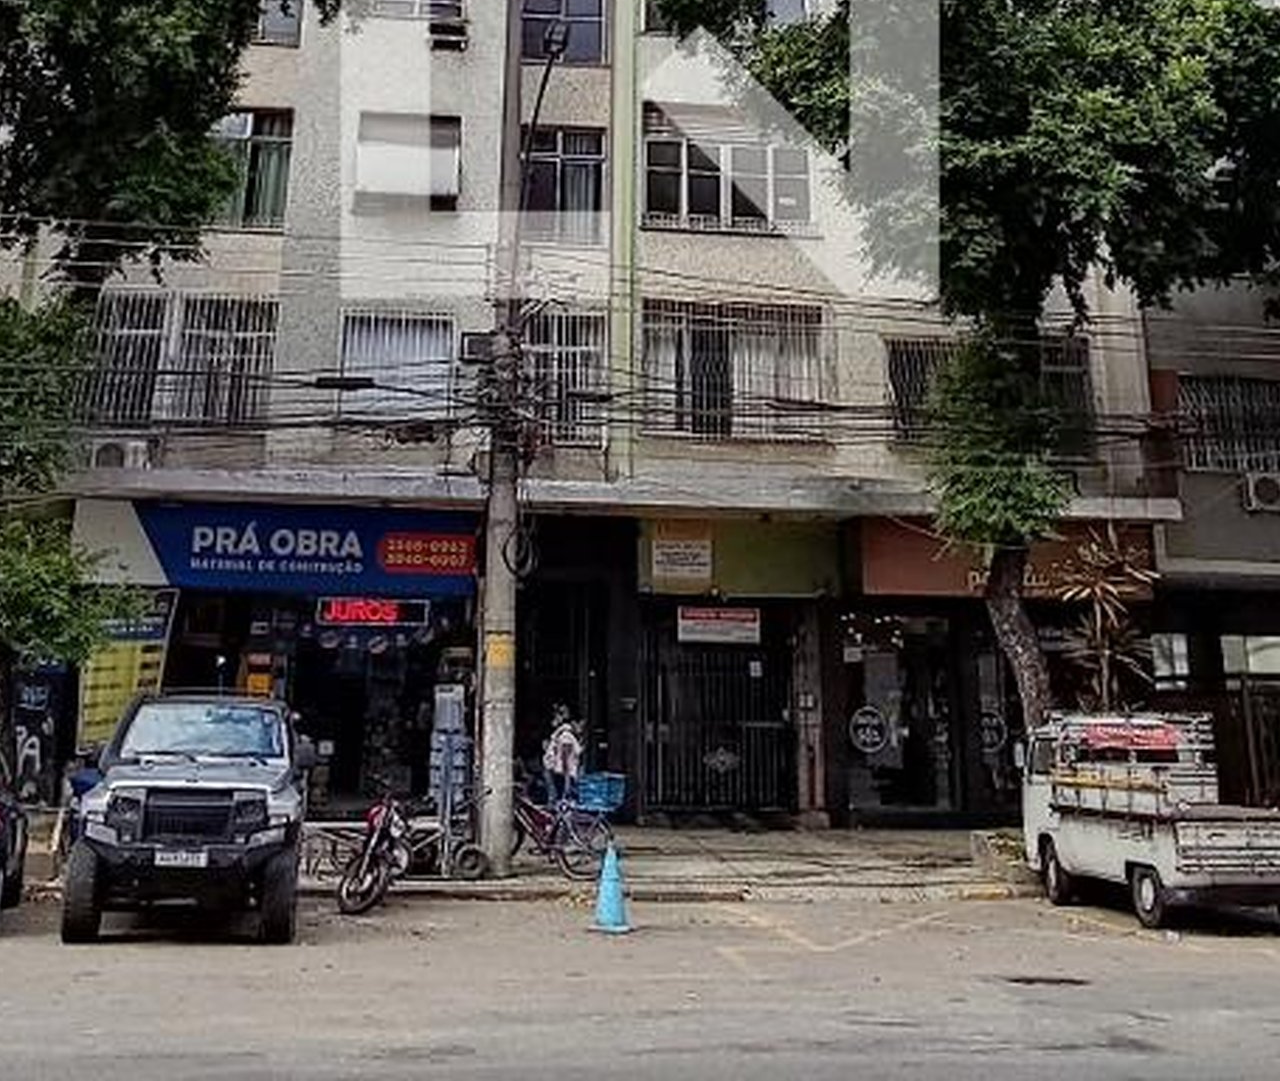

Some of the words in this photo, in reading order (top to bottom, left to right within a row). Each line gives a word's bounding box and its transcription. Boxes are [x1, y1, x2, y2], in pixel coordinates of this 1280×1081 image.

[192, 521, 261, 555] PRÁ
[270, 529, 364, 558] OBRA
[190, 557, 253, 571] MATERIAL
[258, 561, 275, 572] DE
[323, 600, 400, 621] JUROS
